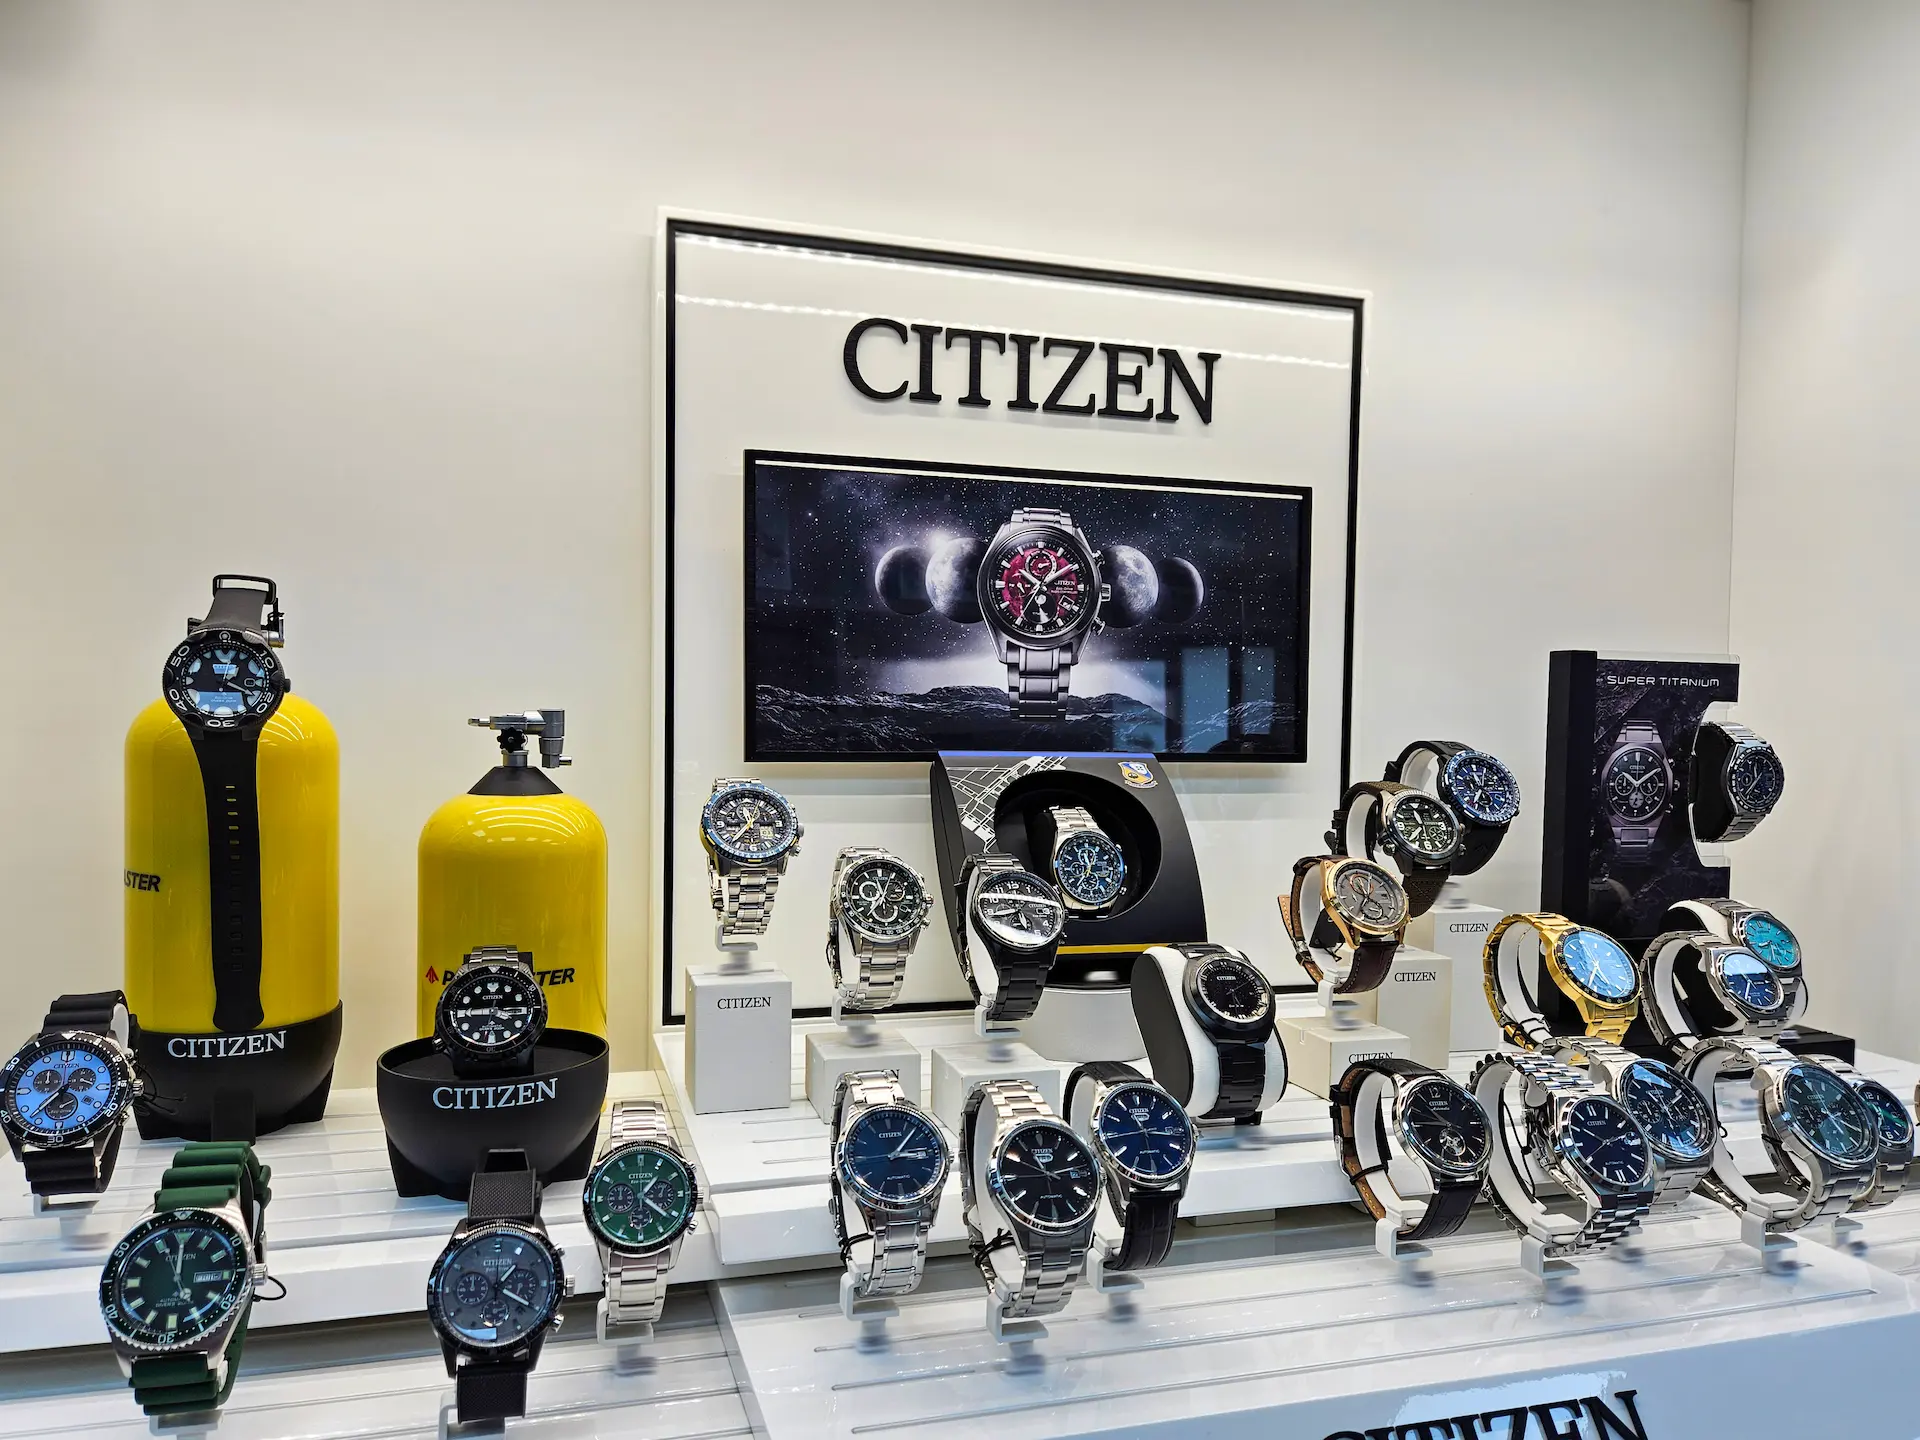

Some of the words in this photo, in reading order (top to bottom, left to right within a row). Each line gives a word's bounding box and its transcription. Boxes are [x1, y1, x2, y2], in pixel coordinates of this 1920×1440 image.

[843, 317, 1222, 425] CITIZEN
[170, 645, 190, 667] 50
[260, 650, 275, 669] 10
[1606, 675, 1656, 686] SUPER
[1659, 677, 1720, 687] TITANIUM
[168, 688, 188, 712] 40
[256, 692, 274, 713] 20
[207, 719, 235, 728] 30
[1397, 821, 1405, 831] 9
[749, 844, 758, 852] 6
[1423, 840, 1433, 850] 6
[1449, 923, 1489, 933] CITIZEN
[1394, 972, 1437, 982] CITIZEN
[717, 996, 771, 1009] CITIZEN
[168, 1030, 287, 1058] CITIZEN
[6, 1057, 20, 1071] 50
[1348, 1051, 1394, 1064] CITIZEN
[432, 1077, 558, 1109] CITIZEN
[1429, 1087, 1441, 1099] 12
[0, 1109, 12, 1124] 40
[104, 1102, 118, 1118] 20
[47, 1135, 64, 1143] 30
[628, 1172, 653, 1180] CITIZEN
[229, 1233, 242, 1247] 10
[114, 1242, 130, 1257] 50
[165, 1253, 196, 1261] CITEN
[483, 1258, 513, 1267] CITIZEN
[220, 1293, 236, 1310] 20
[105, 1304, 118, 1319] 40
[157, 1333, 175, 1344] 30
